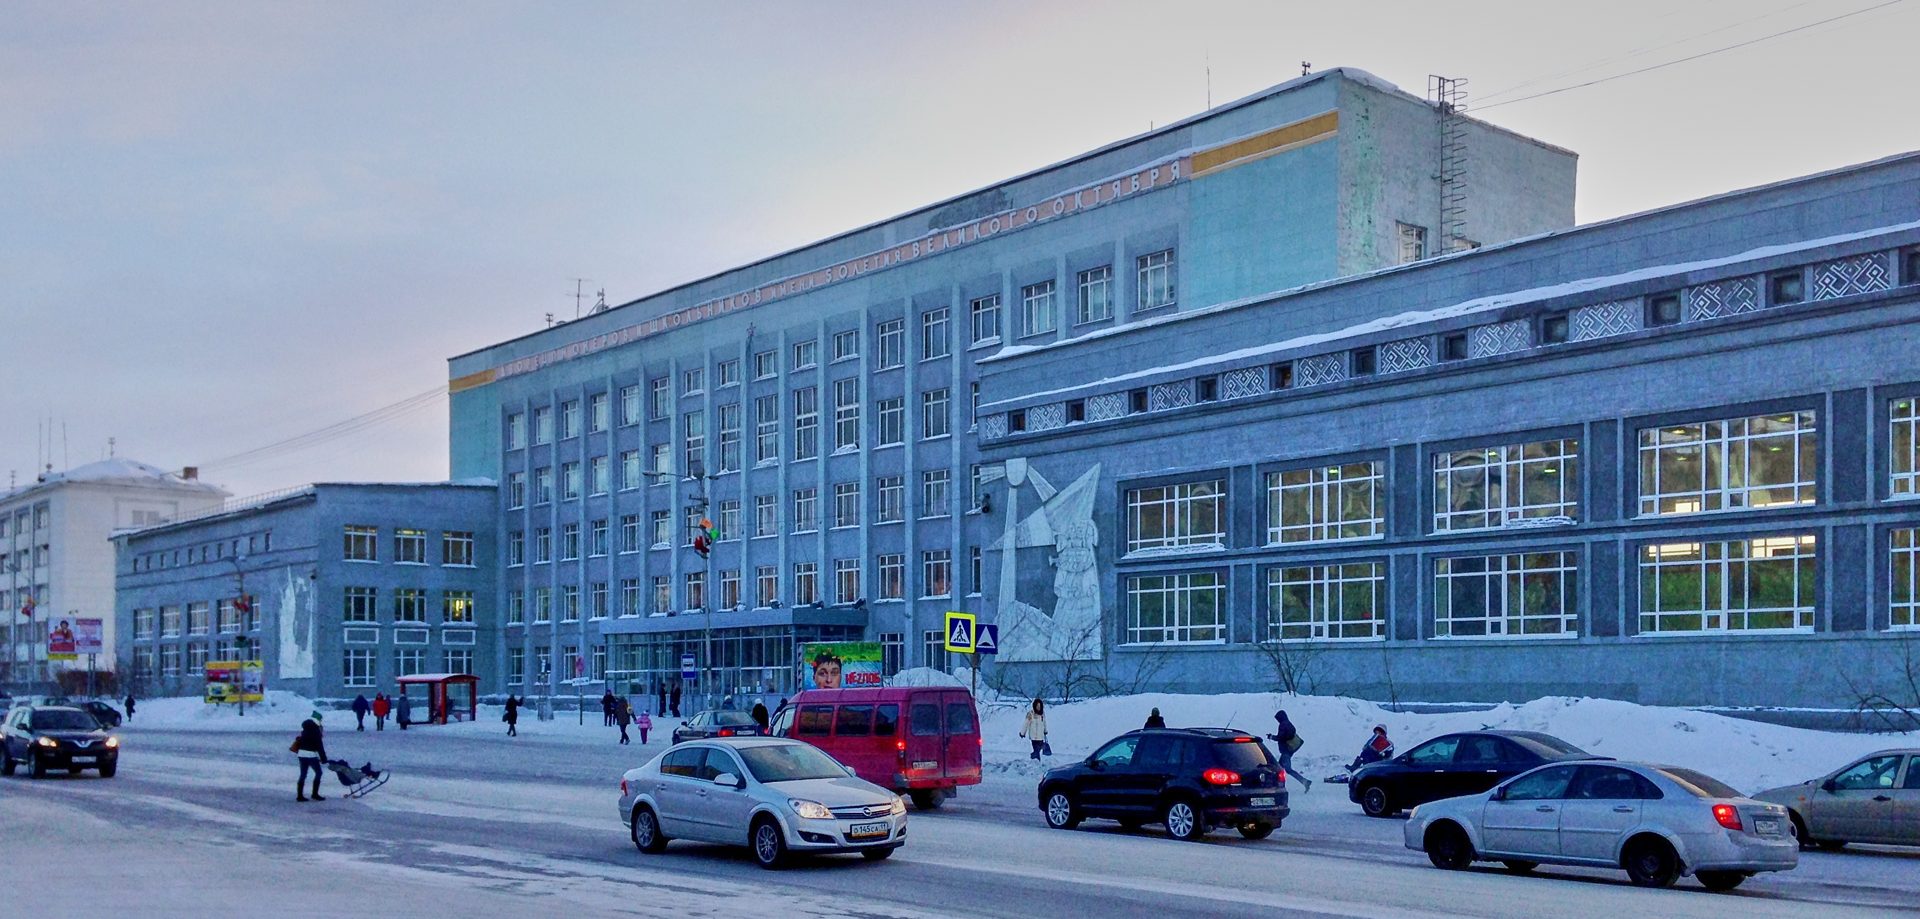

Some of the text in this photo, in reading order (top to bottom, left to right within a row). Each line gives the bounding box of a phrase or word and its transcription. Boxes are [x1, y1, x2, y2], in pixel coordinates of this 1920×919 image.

[649, 290, 762, 333] ШКОЛЬНИКОВ
[912, 206, 1038, 258] ВЕЛИКОГО
[1053, 161, 1180, 214] ОКТЯБРЯ
